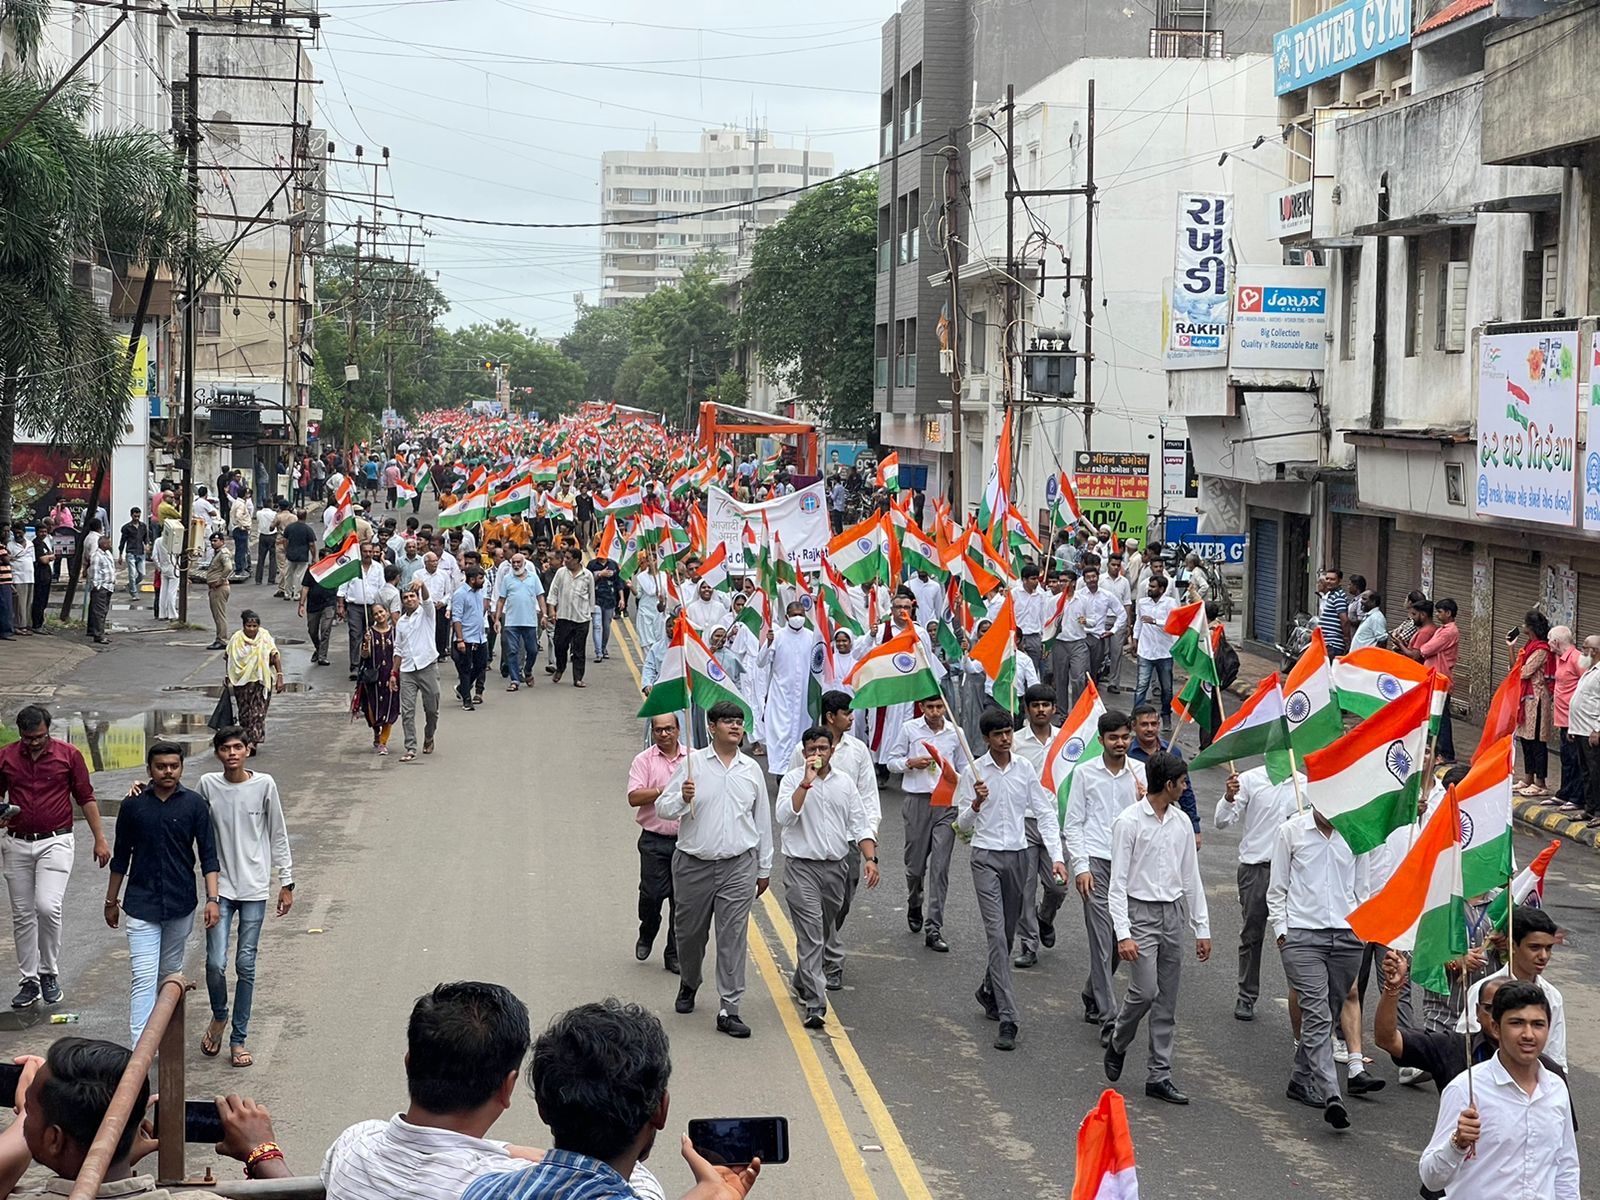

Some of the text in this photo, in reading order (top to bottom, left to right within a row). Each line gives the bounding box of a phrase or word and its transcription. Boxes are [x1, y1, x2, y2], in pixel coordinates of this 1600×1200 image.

[1294, 0, 1405, 79] POWER GYM
[1175, 323, 1225, 335] RAKHI
[1260, 328, 1301, 338] Big Collection
[1240, 339, 1263, 349] Quality
[1270, 340, 1304, 350] Reasonable
[1305, 341, 1319, 350] Rate
[1481, 421, 1573, 472] હર ઘર તિરંગા
